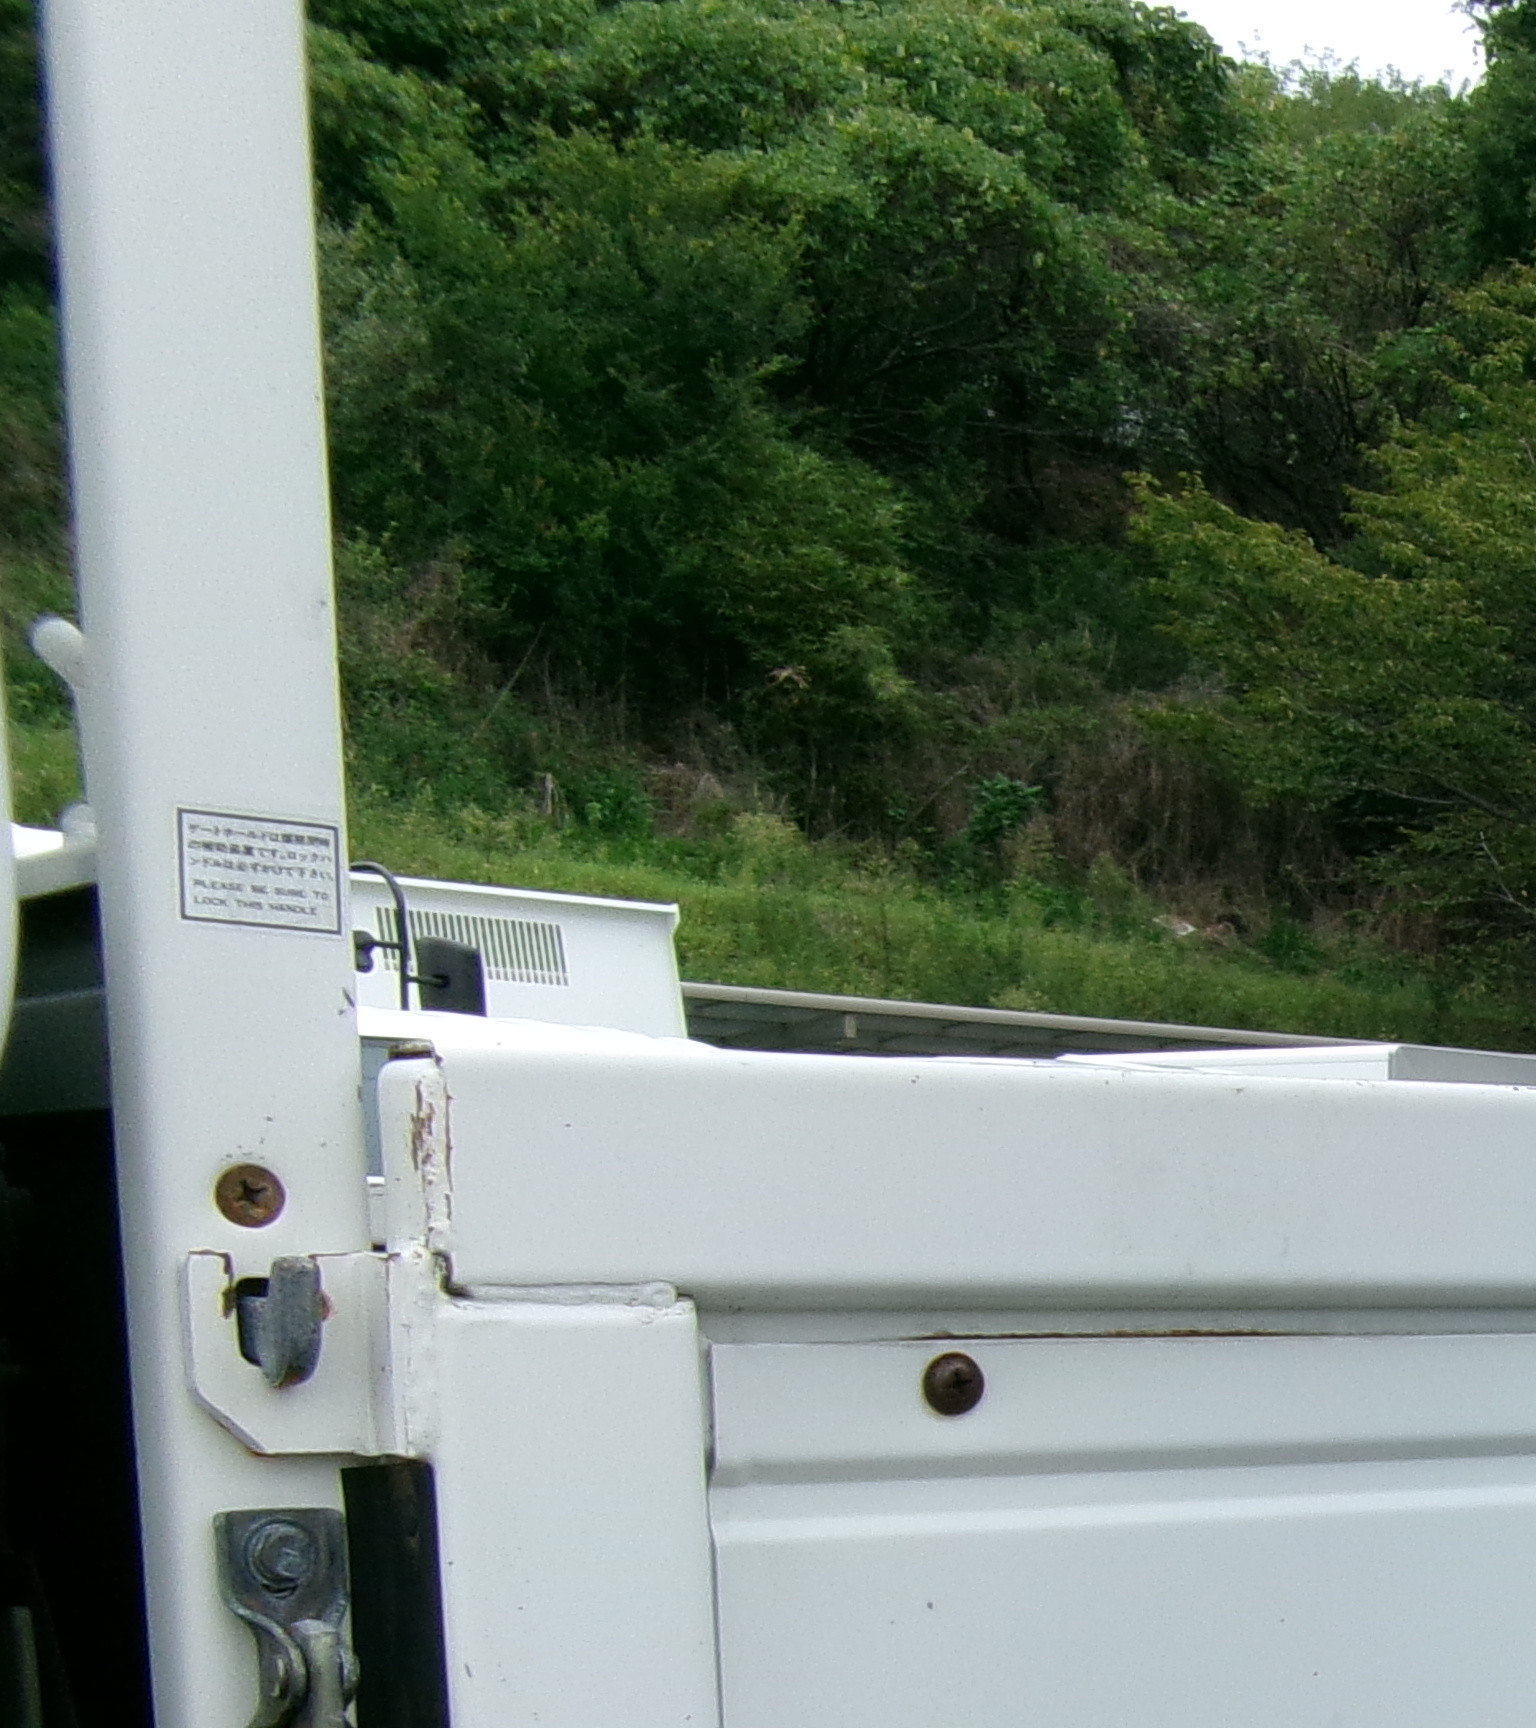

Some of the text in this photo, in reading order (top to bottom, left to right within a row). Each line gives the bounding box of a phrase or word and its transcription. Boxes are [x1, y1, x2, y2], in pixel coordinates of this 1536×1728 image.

[192, 879, 244, 893] PLEASE
[313, 891, 329, 901] TO
[193, 895, 228, 908] LOCK
[235, 899, 263, 911] THIS
